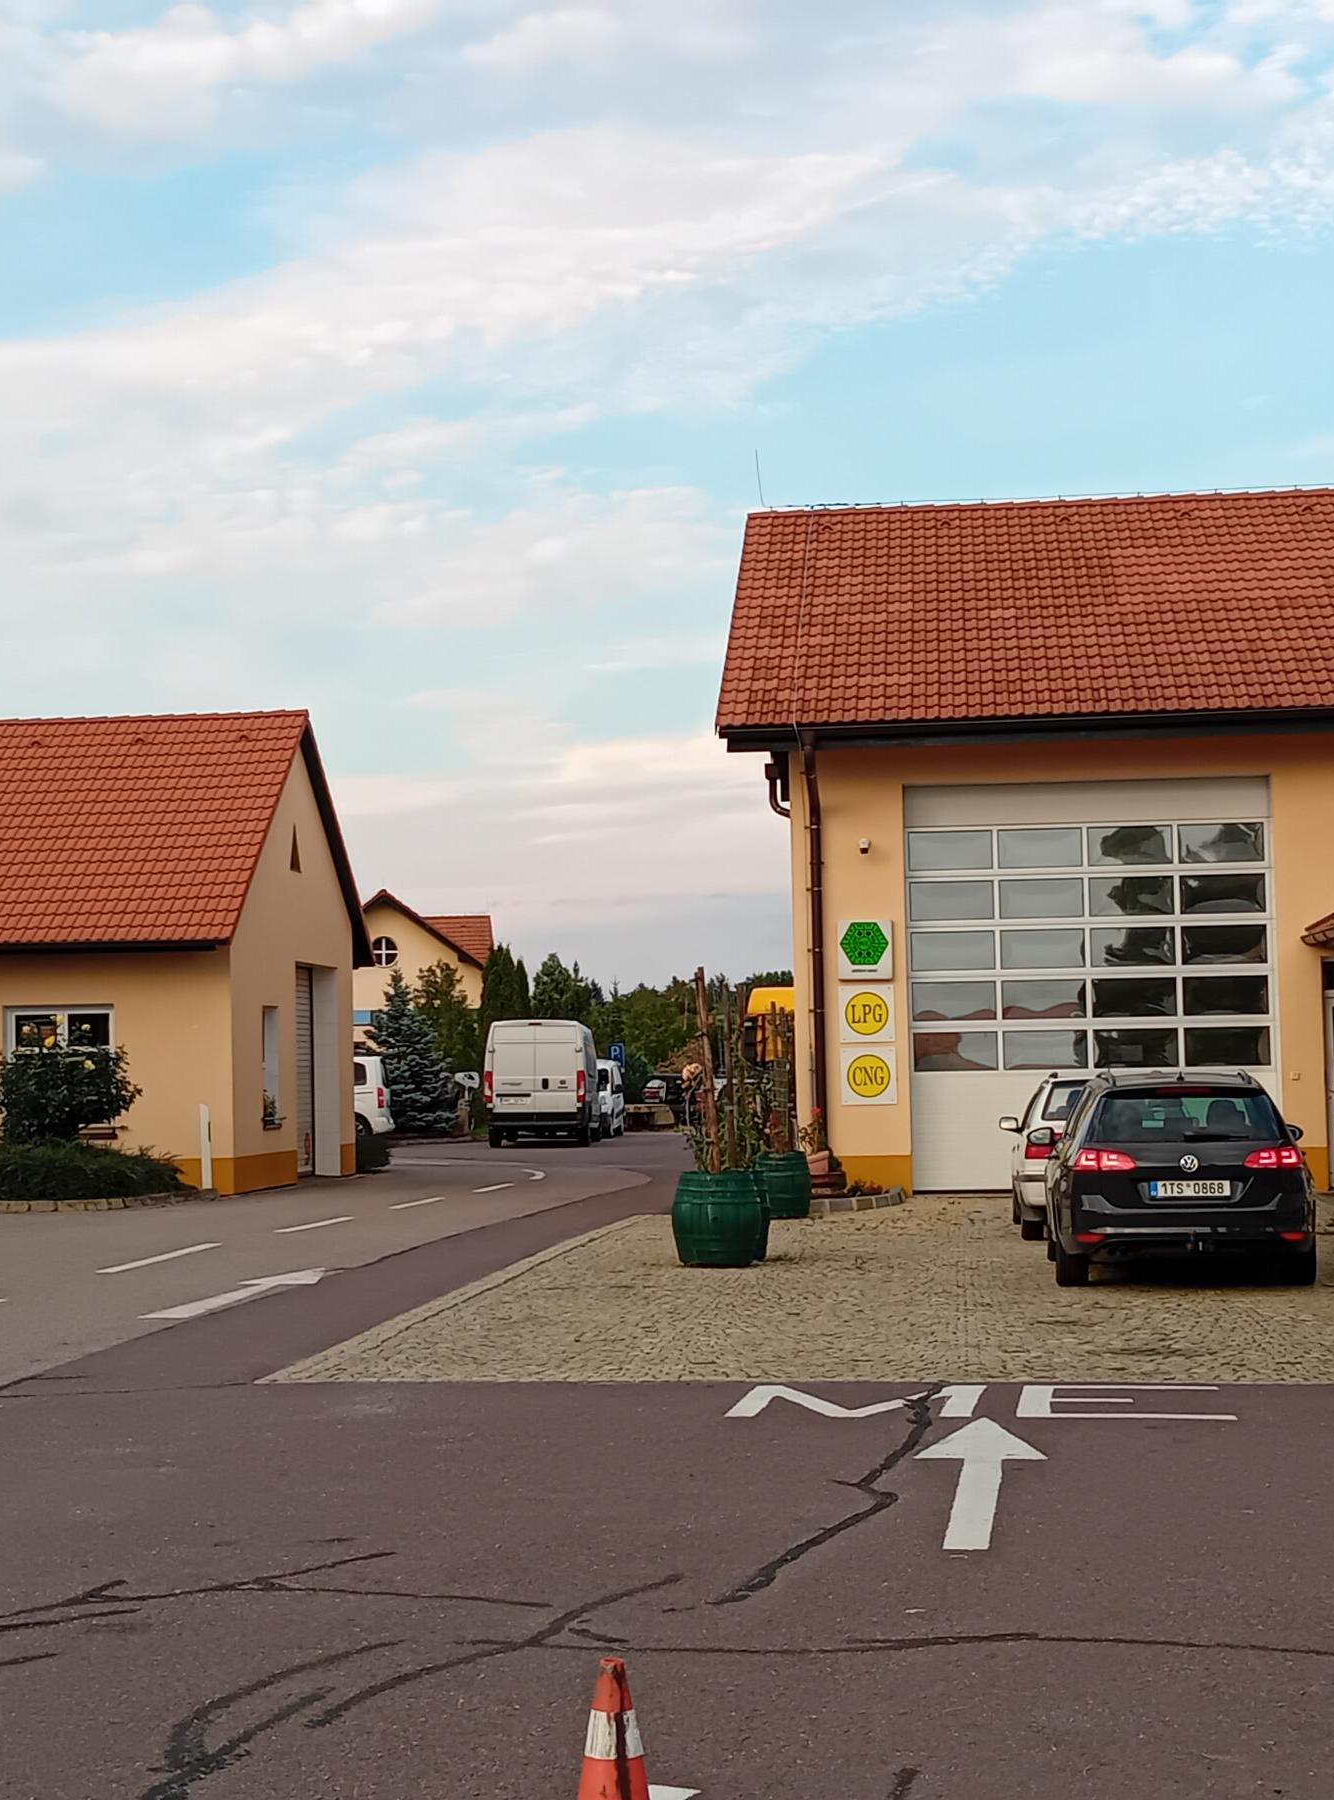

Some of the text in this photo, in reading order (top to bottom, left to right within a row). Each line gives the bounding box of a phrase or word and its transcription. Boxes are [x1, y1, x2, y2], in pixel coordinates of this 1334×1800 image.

[851, 1004, 883, 1024] LPG
[610, 1046, 620, 1060] P
[852, 1066, 885, 1086] CNG
[1161, 1182, 1224, 1195] 1TS 0868
